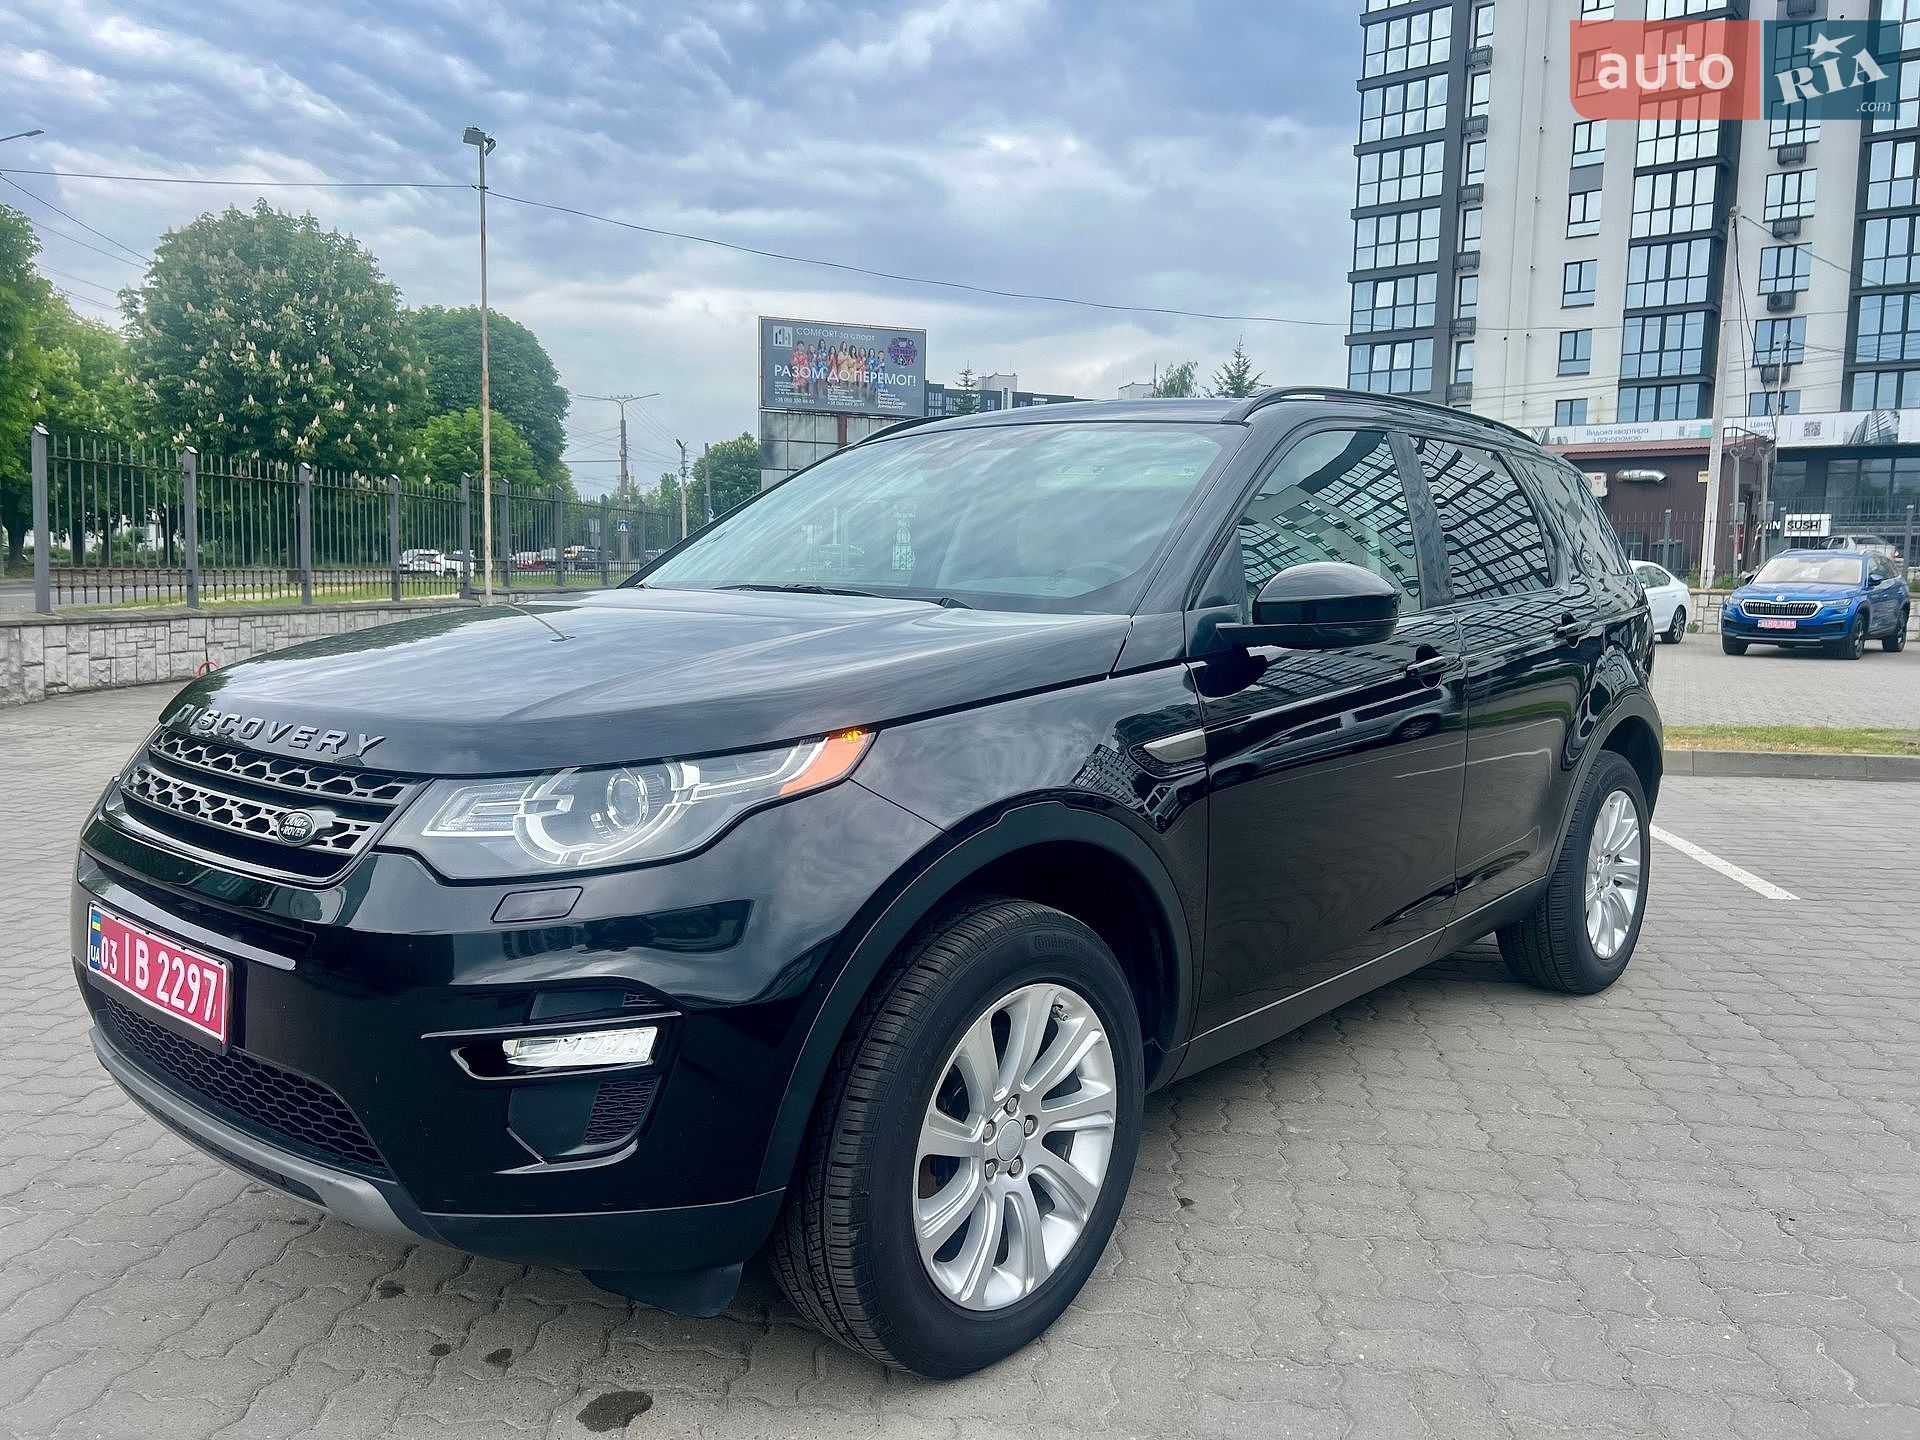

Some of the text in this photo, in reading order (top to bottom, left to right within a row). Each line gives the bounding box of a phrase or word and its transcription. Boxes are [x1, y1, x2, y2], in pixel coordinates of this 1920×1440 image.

[796, 327, 838, 338] COMFORT
[774, 364, 916, 387] РАЗОМ ДО ПЕРЕМОГ!
[1587, 427, 1649, 437] Видова квартира
[1787, 520, 1821, 530] SUSHI
[174, 703, 386, 757] DISCOVERY
[284, 816, 305, 827] LAND
[283, 825, 307, 838] ROVER
[91, 945, 100, 964] UA
[101, 932, 218, 1022] 03 IB 2297
